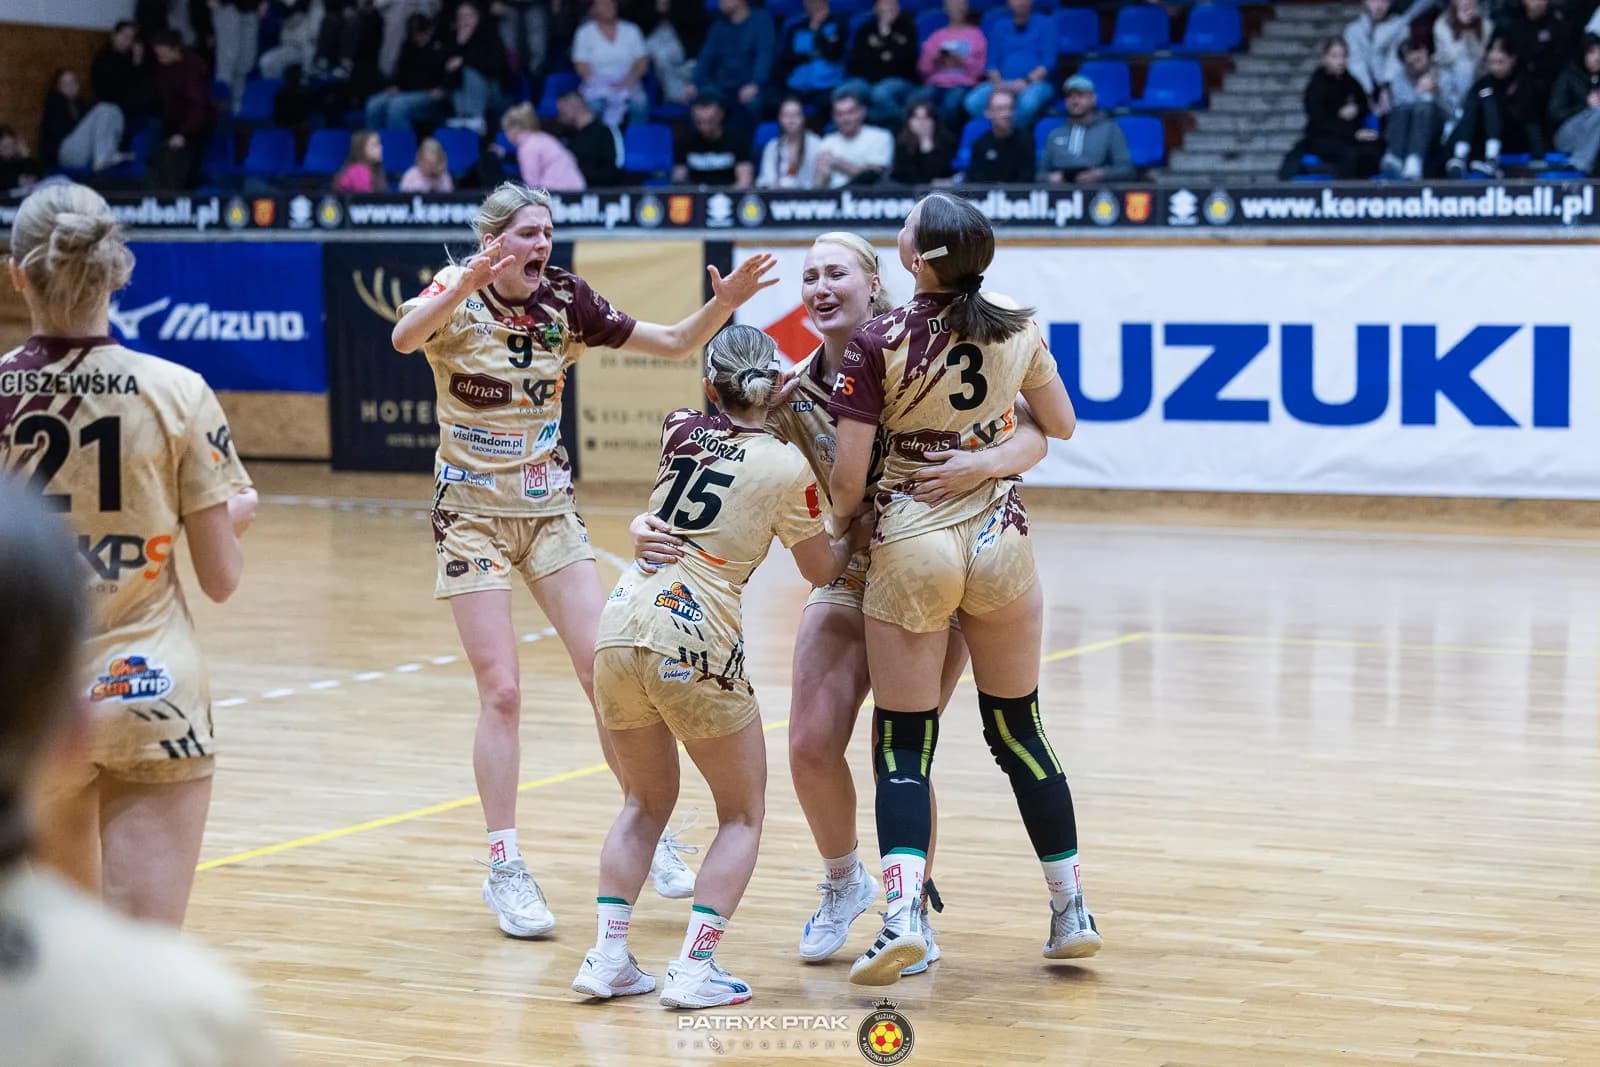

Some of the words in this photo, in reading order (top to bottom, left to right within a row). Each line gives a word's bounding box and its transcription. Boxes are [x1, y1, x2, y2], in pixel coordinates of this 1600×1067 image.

[1241, 186, 1593, 224] www.koronahandball.pl
[507, 334, 533, 368] 9
[457, 380, 503, 399] elmas
[946, 343, 988, 411] 3
[1049, 322, 1571, 428] UZUKI
[360, 401, 432, 424] HOTE
[453, 430, 523, 448] visitRadom.pl
[689, 427, 748, 463] SKORŻA
[901, 437, 950, 453] elmas
[13, 415, 122, 513] 21
[655, 457, 736, 531] 15
